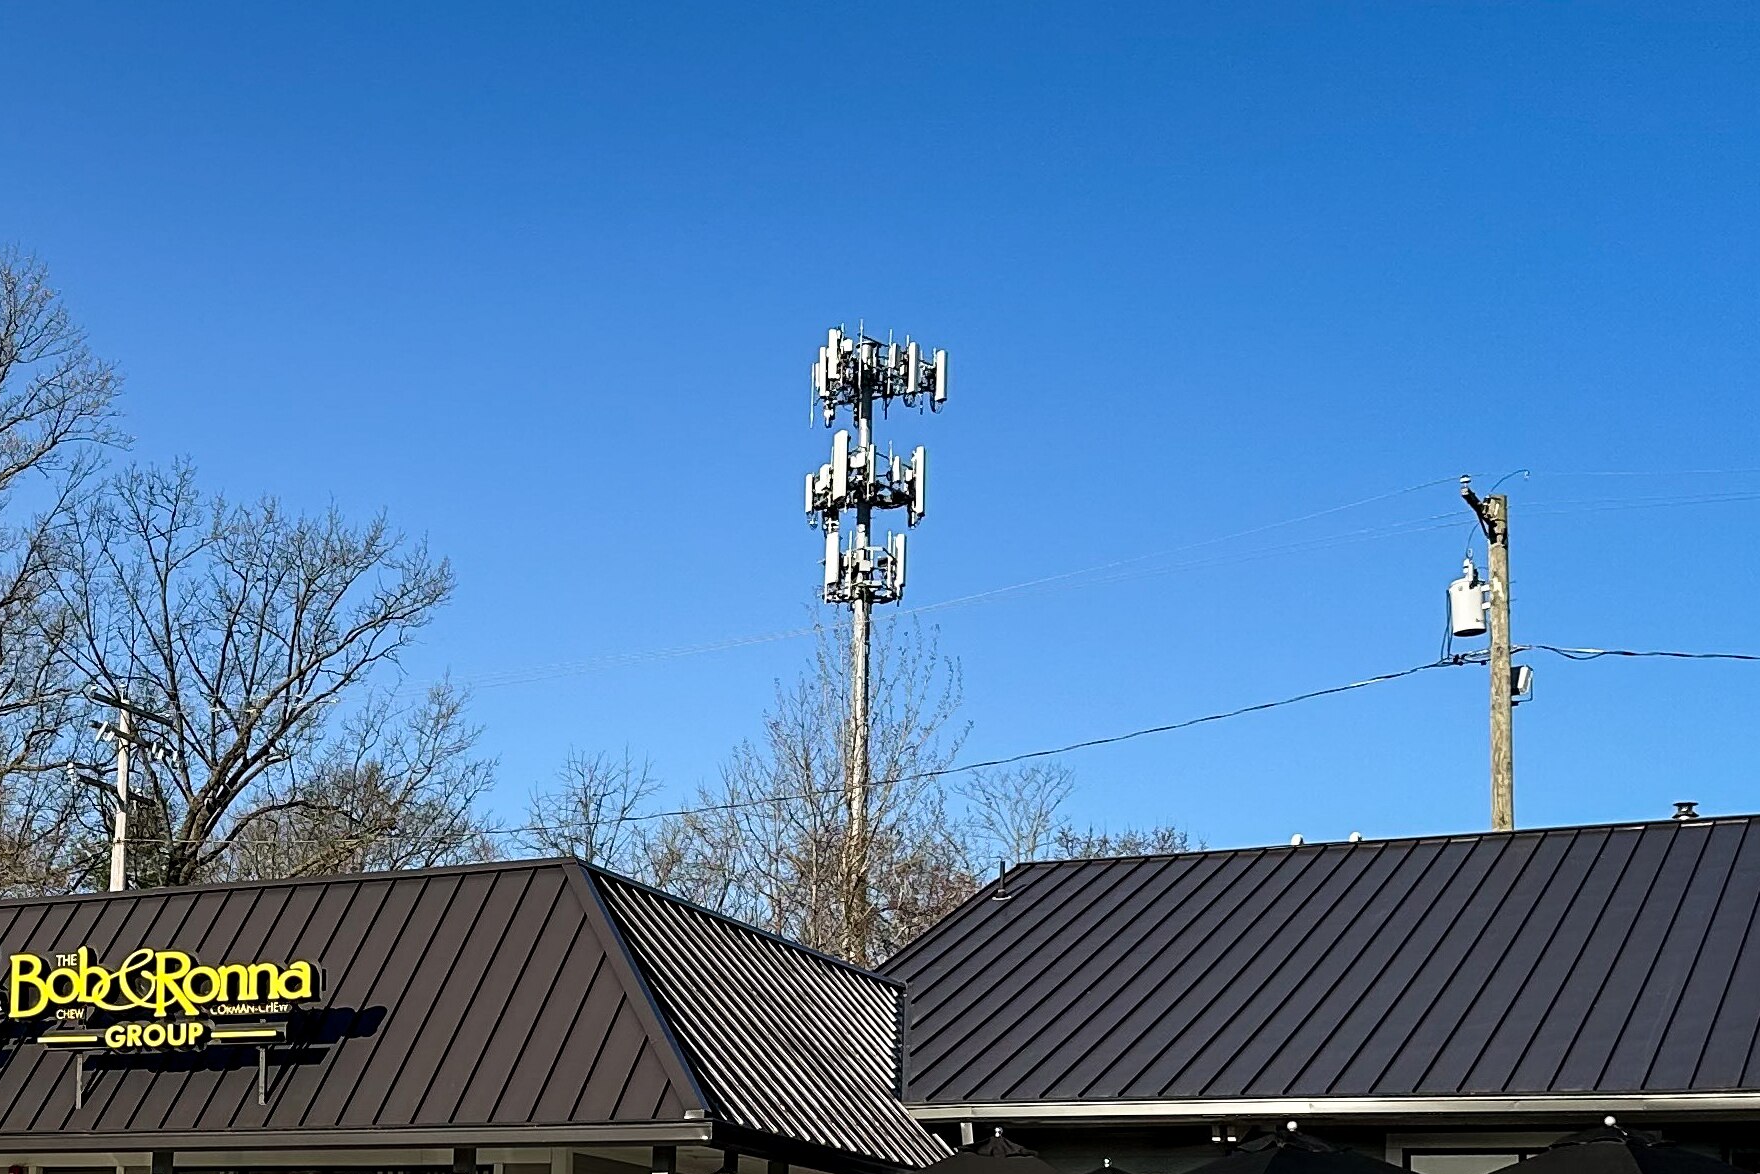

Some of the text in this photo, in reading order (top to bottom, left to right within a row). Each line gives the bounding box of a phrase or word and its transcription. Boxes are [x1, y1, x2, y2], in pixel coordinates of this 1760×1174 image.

[55, 953, 77, 967] THE
[8, 946, 111, 1018] Bob
[154, 951, 311, 1017] Ronna
[55, 1008, 85, 1020] CHEW
[104, 1022, 204, 1048] GROUP
